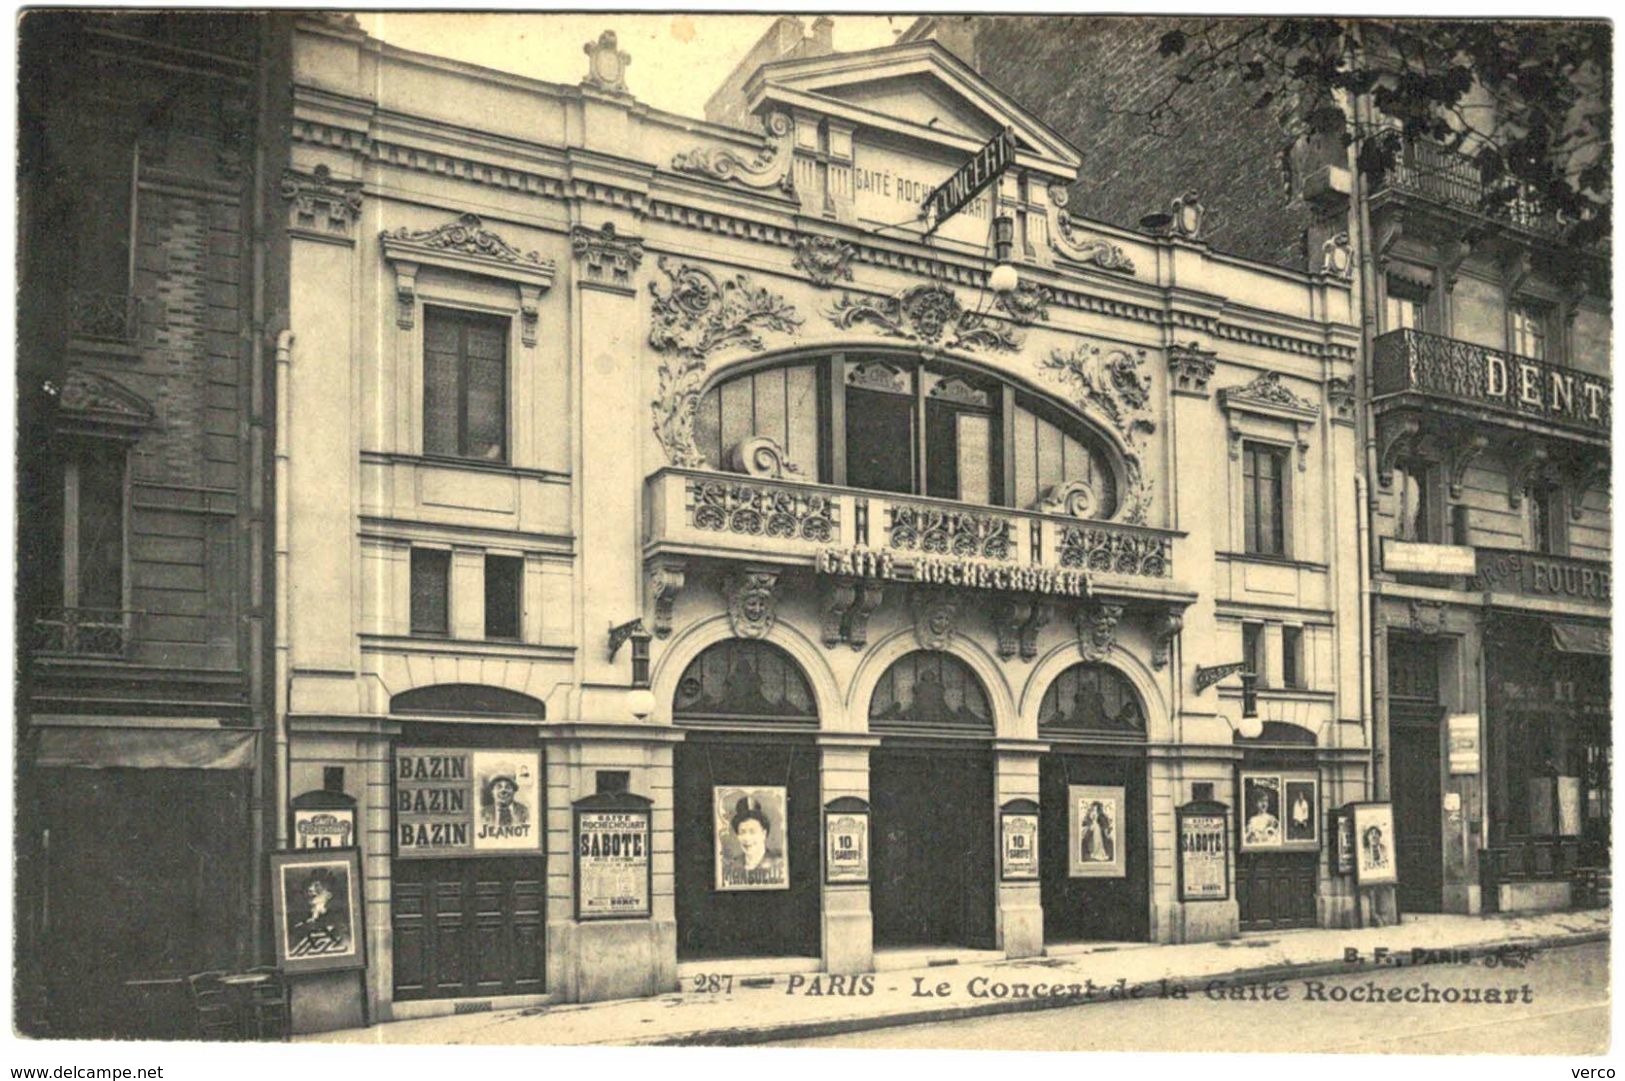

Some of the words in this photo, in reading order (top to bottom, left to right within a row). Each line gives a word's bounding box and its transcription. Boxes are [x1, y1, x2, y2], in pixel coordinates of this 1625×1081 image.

[1486, 356, 1603, 419] DENT
[400, 758, 465, 778] BAZIN
[399, 789, 464, 812] BAZIN
[401, 824, 467, 845] BAZIN
[478, 824, 530, 839] JEANOT
[839, 835, 852, 848] 10
[1012, 835, 1025, 848] 10
